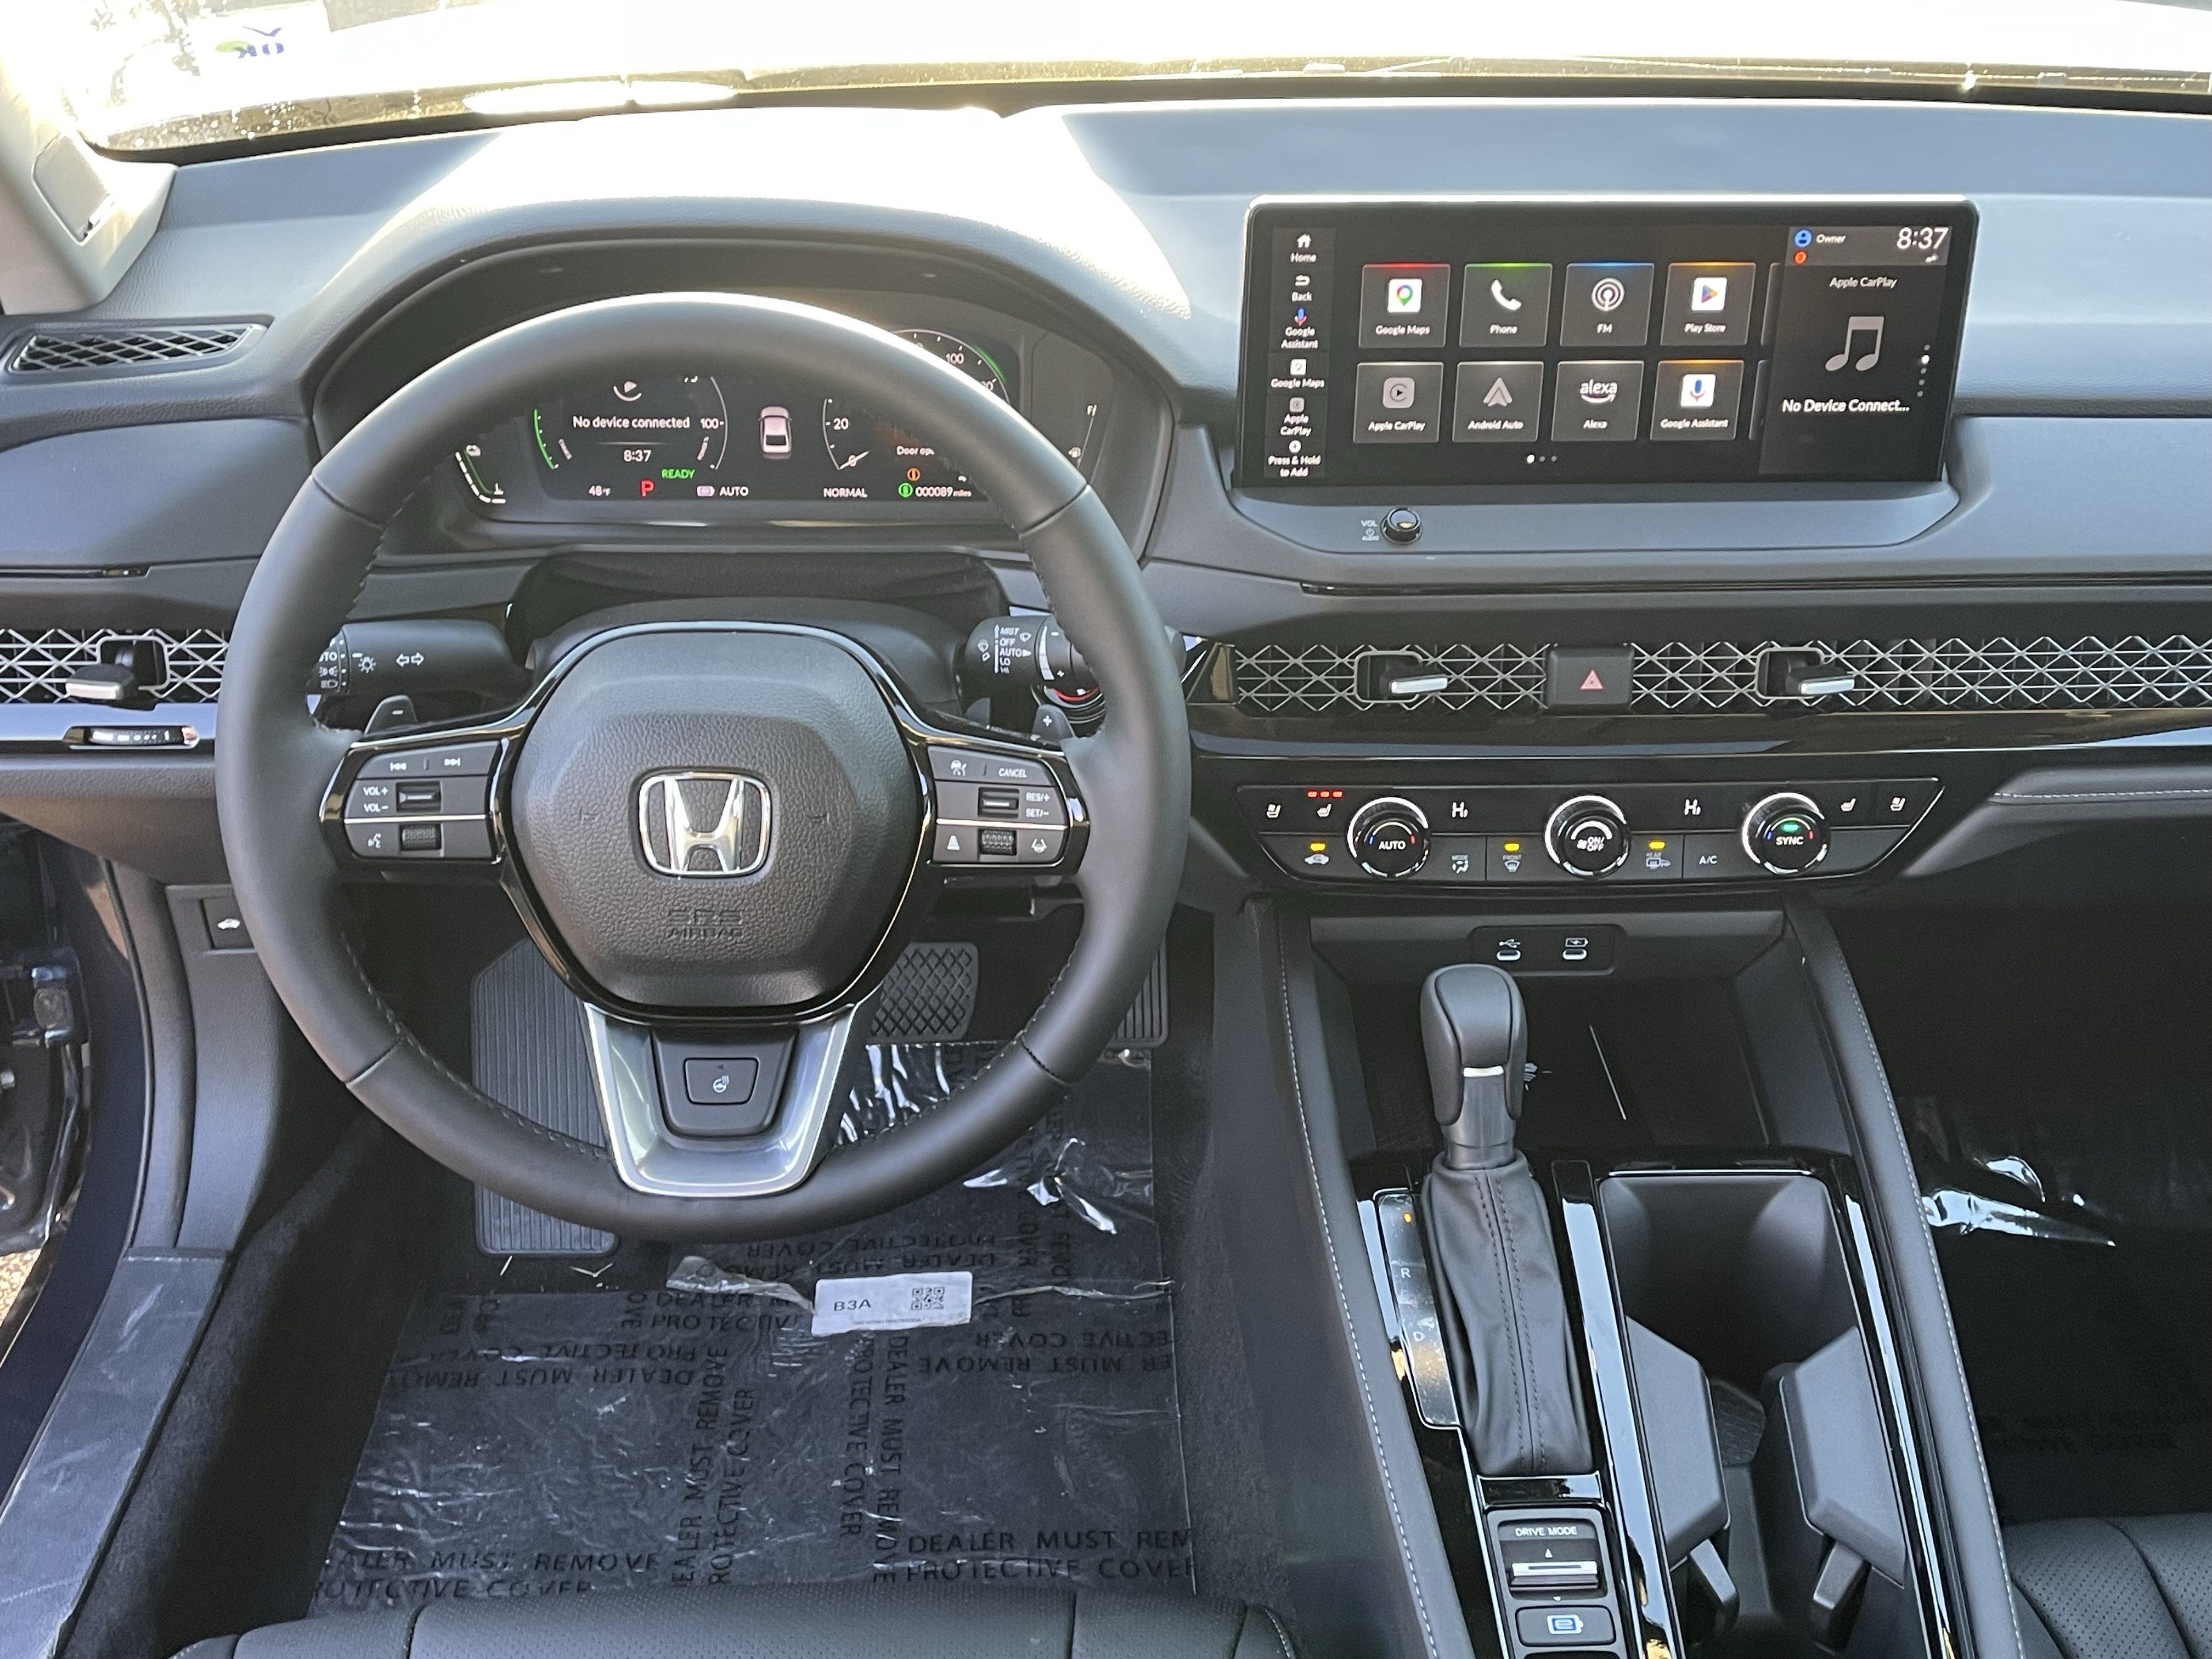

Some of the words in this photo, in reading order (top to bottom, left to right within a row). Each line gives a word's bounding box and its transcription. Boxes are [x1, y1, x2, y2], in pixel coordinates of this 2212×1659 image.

[1816, 234, 1846, 243] Owner
[1896, 227, 1949, 250] 8:37
[1290, 252, 1316, 263] Home
[1830, 278, 1858, 289] Apple
[1860, 278, 1898, 289] CarPlay
[1291, 292, 1312, 302] Back
[1285, 326, 1315, 338] Google
[1376, 325, 1405, 336] Google
[1407, 325, 1430, 335] Maps
[1489, 324, 1518, 334] Phone
[1597, 324, 1612, 334] FM
[1684, 324, 1702, 334] Play
[1704, 324, 1726, 333] Store
[1280, 340, 1318, 349] Assistant
[1271, 379, 1301, 389] Google
[1302, 379, 1325, 388] Maps
[1579, 379, 1618, 394] alexa
[1781, 400, 1802, 413] No
[1804, 399, 1847, 412] Device
[573, 416, 591, 428] No
[592, 416, 630, 428] device
[631, 416, 691, 428] connected
[700, 417, 719, 429] 100
[833, 417, 849, 430] 20
[1284, 414, 1309, 425] Apple
[1583, 420, 1607, 429] Alexa
[1661, 419, 1689, 429] Google
[1691, 419, 1729, 428] Assistant
[1368, 421, 1393, 432] Apple
[1395, 421, 1426, 431] CarPlay
[1468, 421, 1500, 430] Android
[1502, 421, 1524, 430] Auto
[1280, 426, 1312, 437] CarPlay
[624, 449, 652, 462] 8:37
[896, 445, 919, 455] Door
[1268, 455, 1290, 466] Press
[1291, 456, 1299, 465] &
[1301, 455, 1321, 465] Hold
[662, 469, 695, 479] READY
[1280, 468, 1289, 477] to
[1290, 467, 1308, 477] Add
[640, 480, 654, 497] P
[720, 487, 749, 496] AUTO
[823, 488, 868, 498] NORMAL
[1000, 637, 1015, 647] OFF
[1000, 648, 1022, 658] AUTO
[998, 768, 1028, 778] CANCEL
[1378, 840, 1406, 850] AUTO
[1775, 836, 1804, 845] SYNC
[1699, 855, 1718, 865] A/C
[1401, 1267, 1411, 1279] R
[833, 1299, 872, 1312] B3A
[1413, 1331, 1424, 1342] D
[918, 1356, 1031, 1373] REMOVE
[884, 1335, 910, 1406] DEALER
[879, 1418, 905, 1476] MUST
[839, 1461, 867, 1537] COVER
[1515, 1527, 1545, 1537] DRIVE
[1547, 1526, 1577, 1537] MODE
[907, 1532, 1014, 1554] DEALER
[1035, 1529, 1116, 1550] MUST
